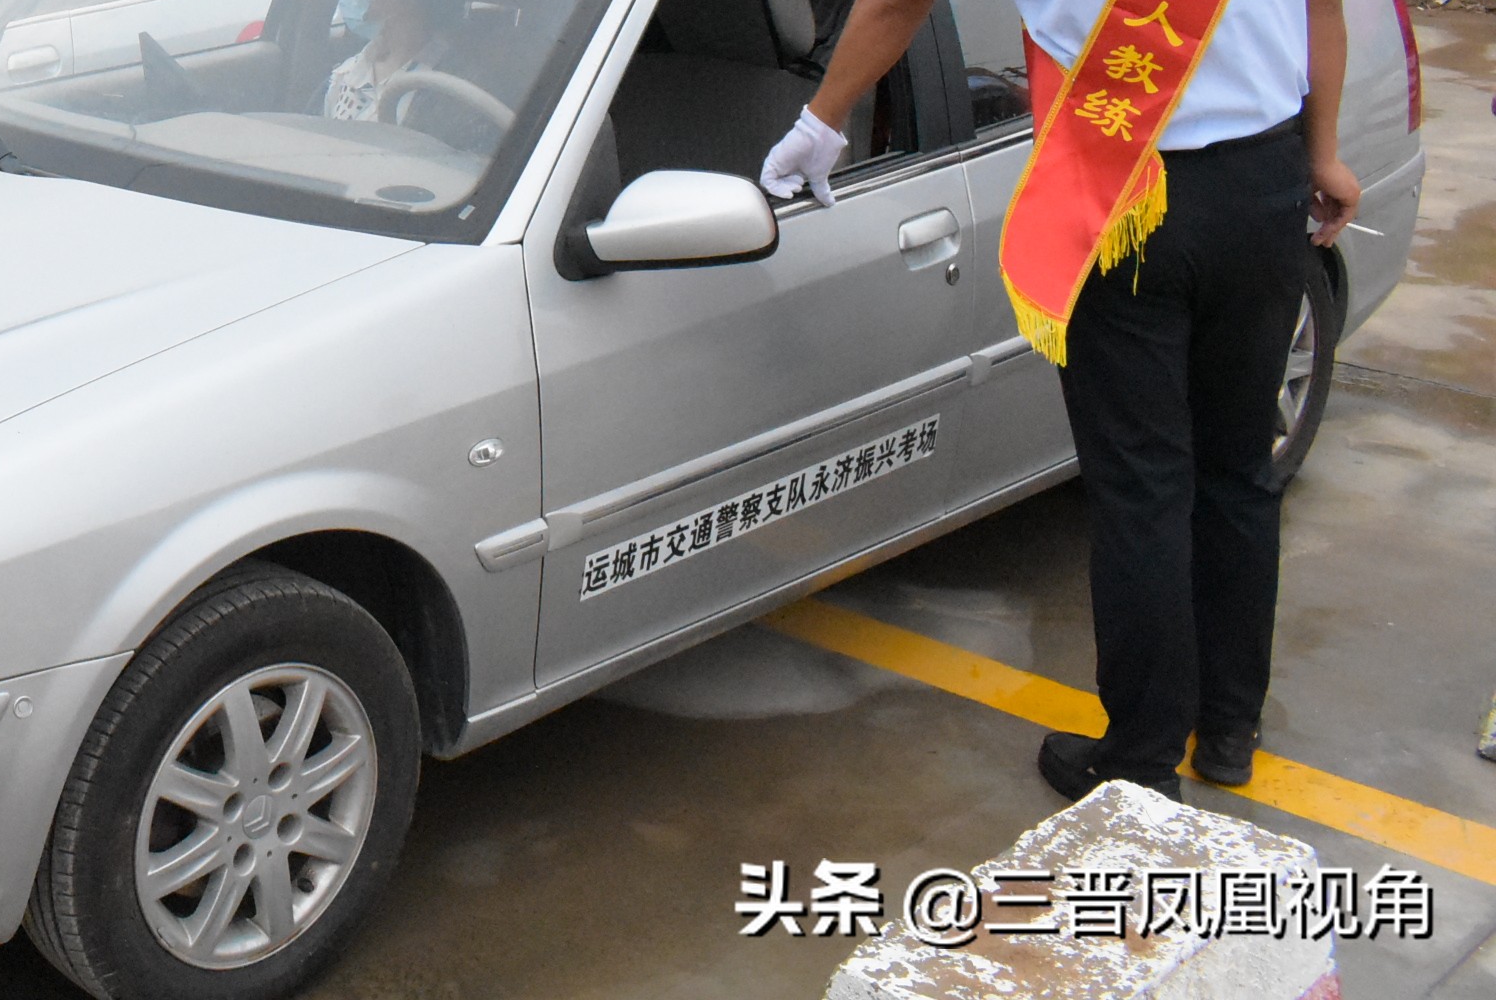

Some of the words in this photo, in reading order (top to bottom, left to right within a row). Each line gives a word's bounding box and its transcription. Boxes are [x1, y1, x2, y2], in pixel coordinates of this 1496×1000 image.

[582, 418, 938, 597] 运城市交通警察支队永济振兴考场
